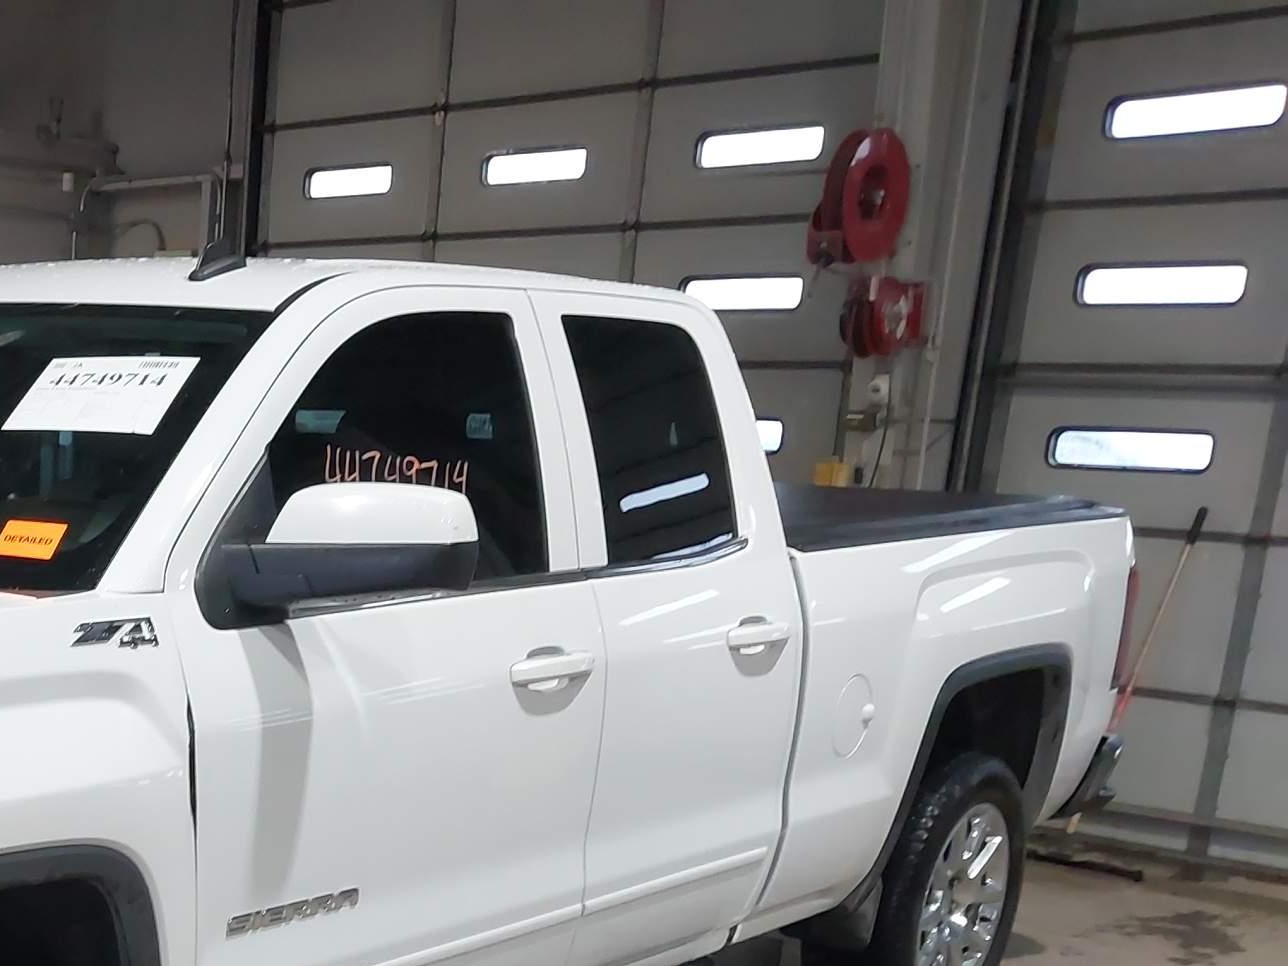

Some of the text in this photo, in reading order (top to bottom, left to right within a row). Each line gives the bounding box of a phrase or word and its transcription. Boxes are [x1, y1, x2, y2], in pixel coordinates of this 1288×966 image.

[48, 372, 168, 387] 44749714
[324, 443, 469, 495] 44749714
[3, 534, 53, 545] DETAILED
[225, 887, 359, 937] SIERRA
